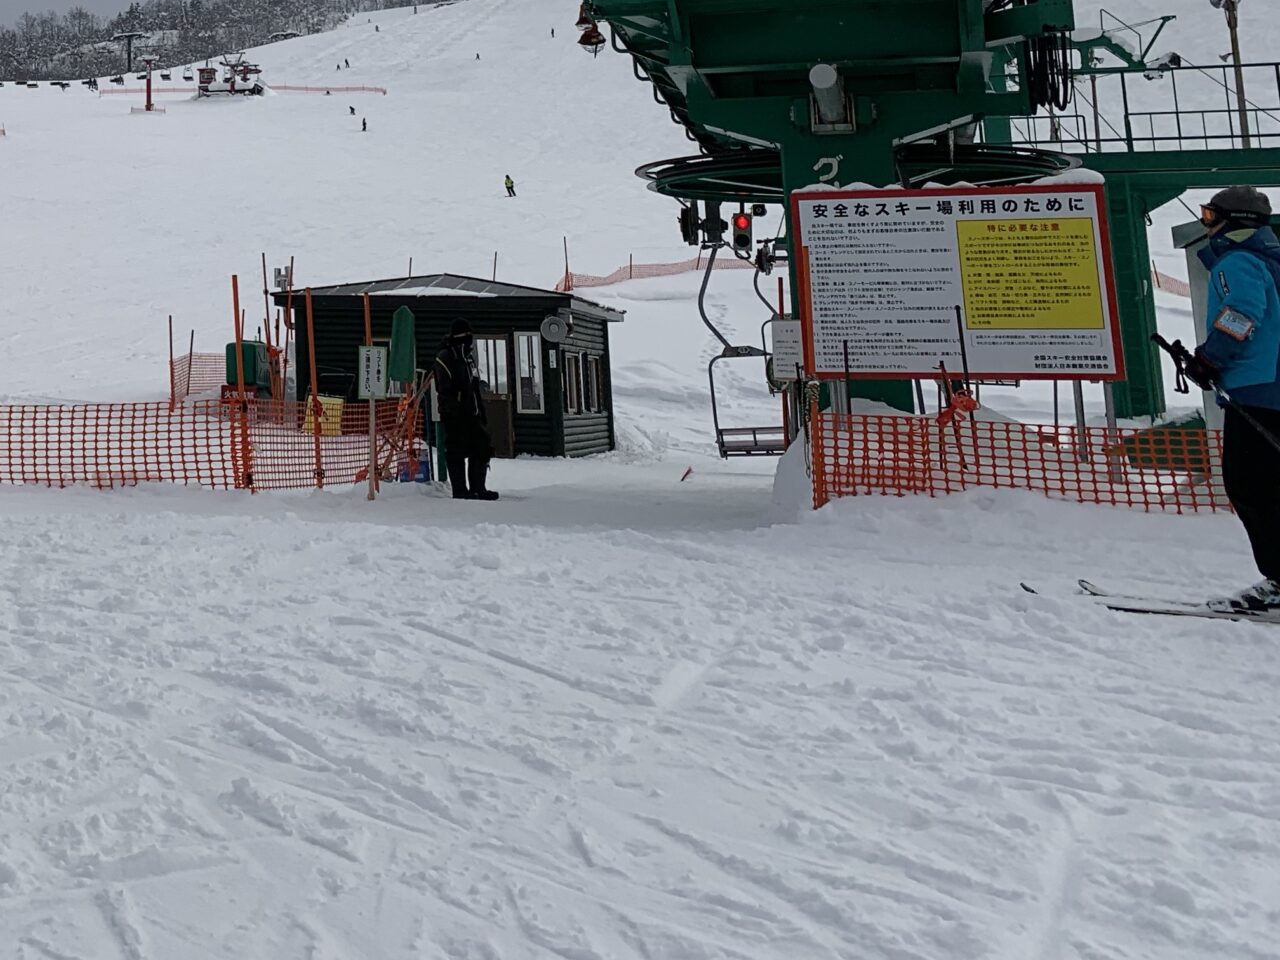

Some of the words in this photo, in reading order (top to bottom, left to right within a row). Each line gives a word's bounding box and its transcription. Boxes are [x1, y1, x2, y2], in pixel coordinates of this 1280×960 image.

[813, 154, 843, 188] グ
[812, 198, 1085, 218] 安全なスキー場利用のために
[986, 223, 1061, 233] 特に必要な注意
